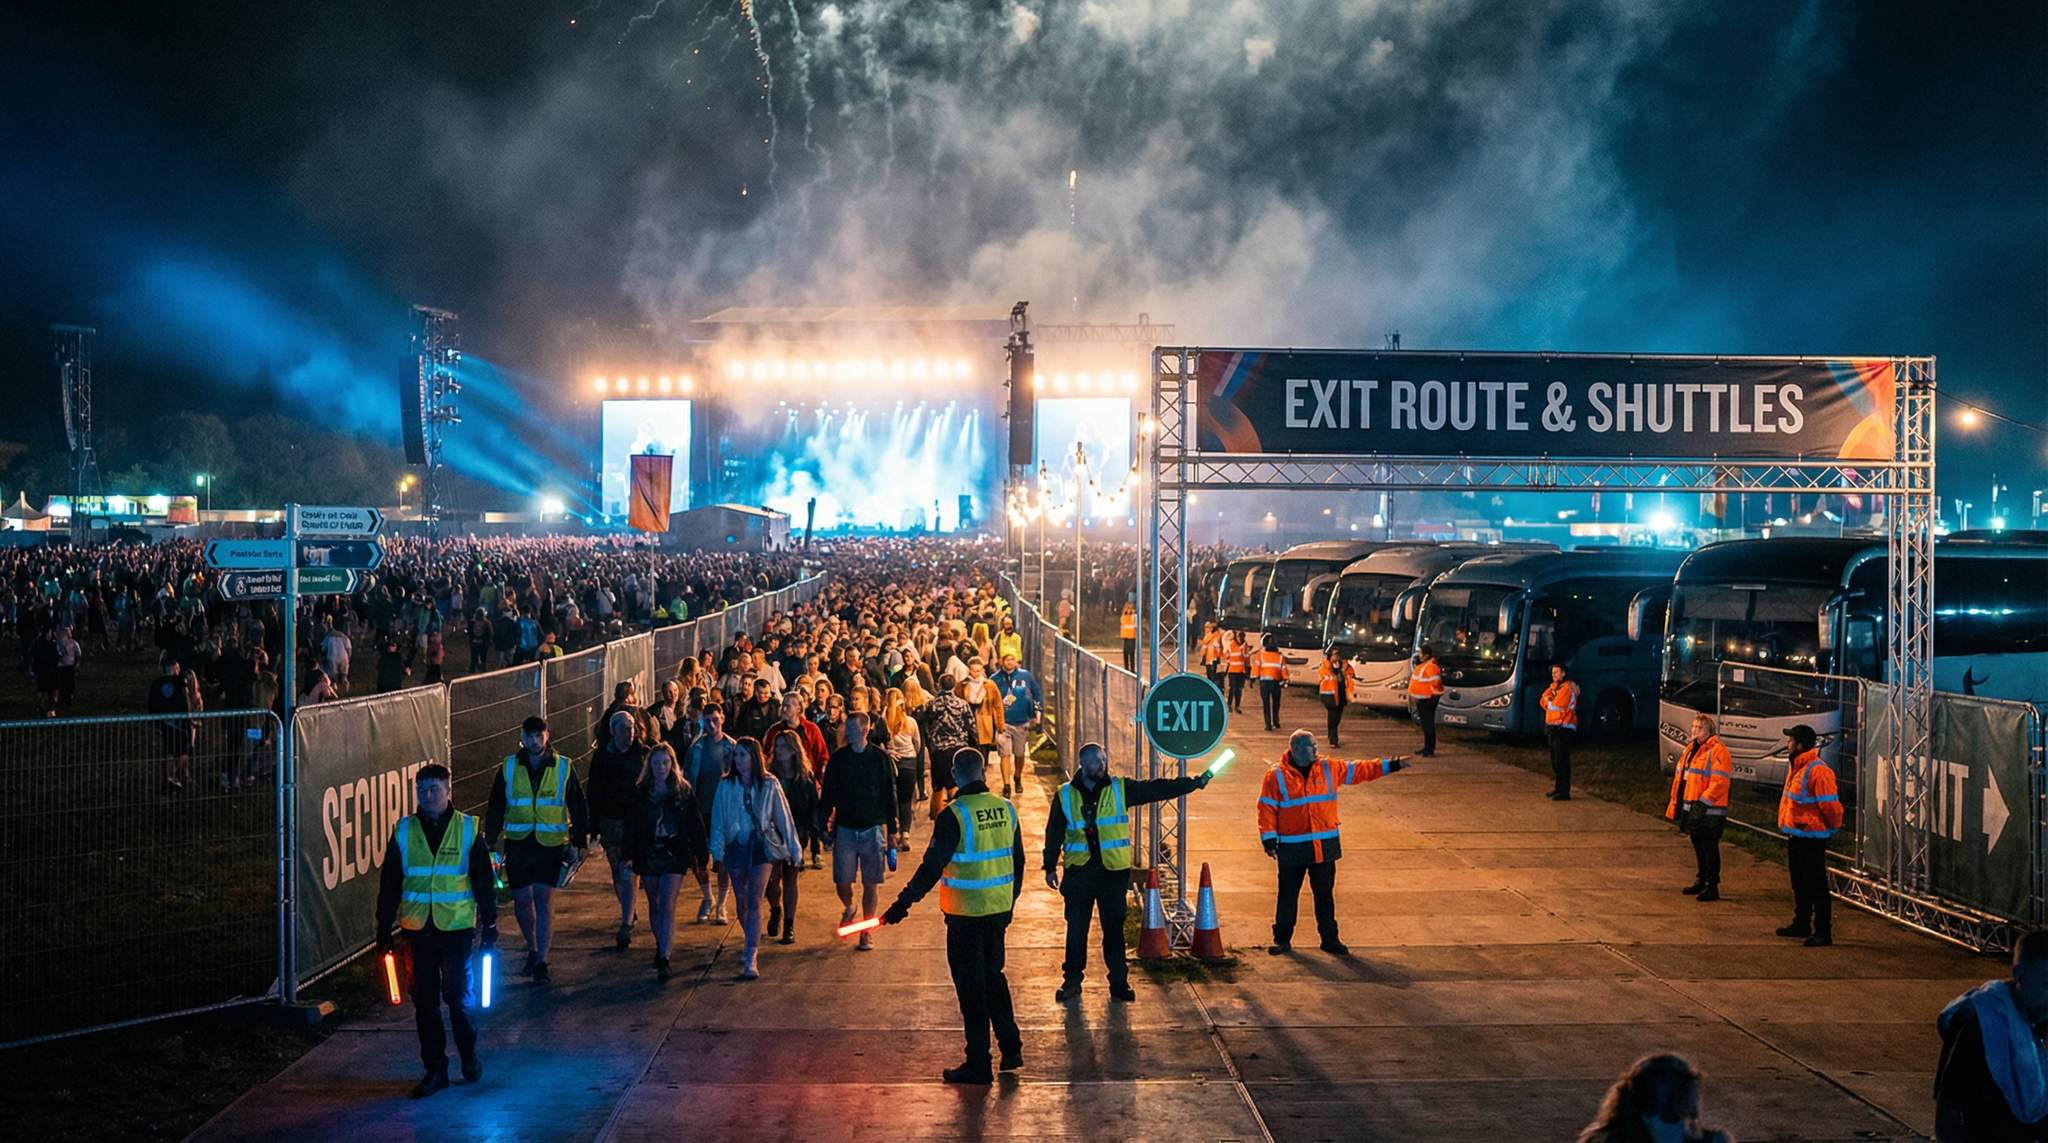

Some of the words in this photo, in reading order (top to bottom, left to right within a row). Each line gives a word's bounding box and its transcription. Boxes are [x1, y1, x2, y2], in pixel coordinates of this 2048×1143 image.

[1285, 379, 1378, 428] EXIT
[1391, 380, 1529, 430] ROUTE
[1541, 381, 1576, 432] &
[1587, 382, 1804, 434] SHUTTLES
[1157, 700, 1214, 732] EXIT
[322, 759, 435, 890] SECURIT
[976, 807, 1005, 822] EXIT
